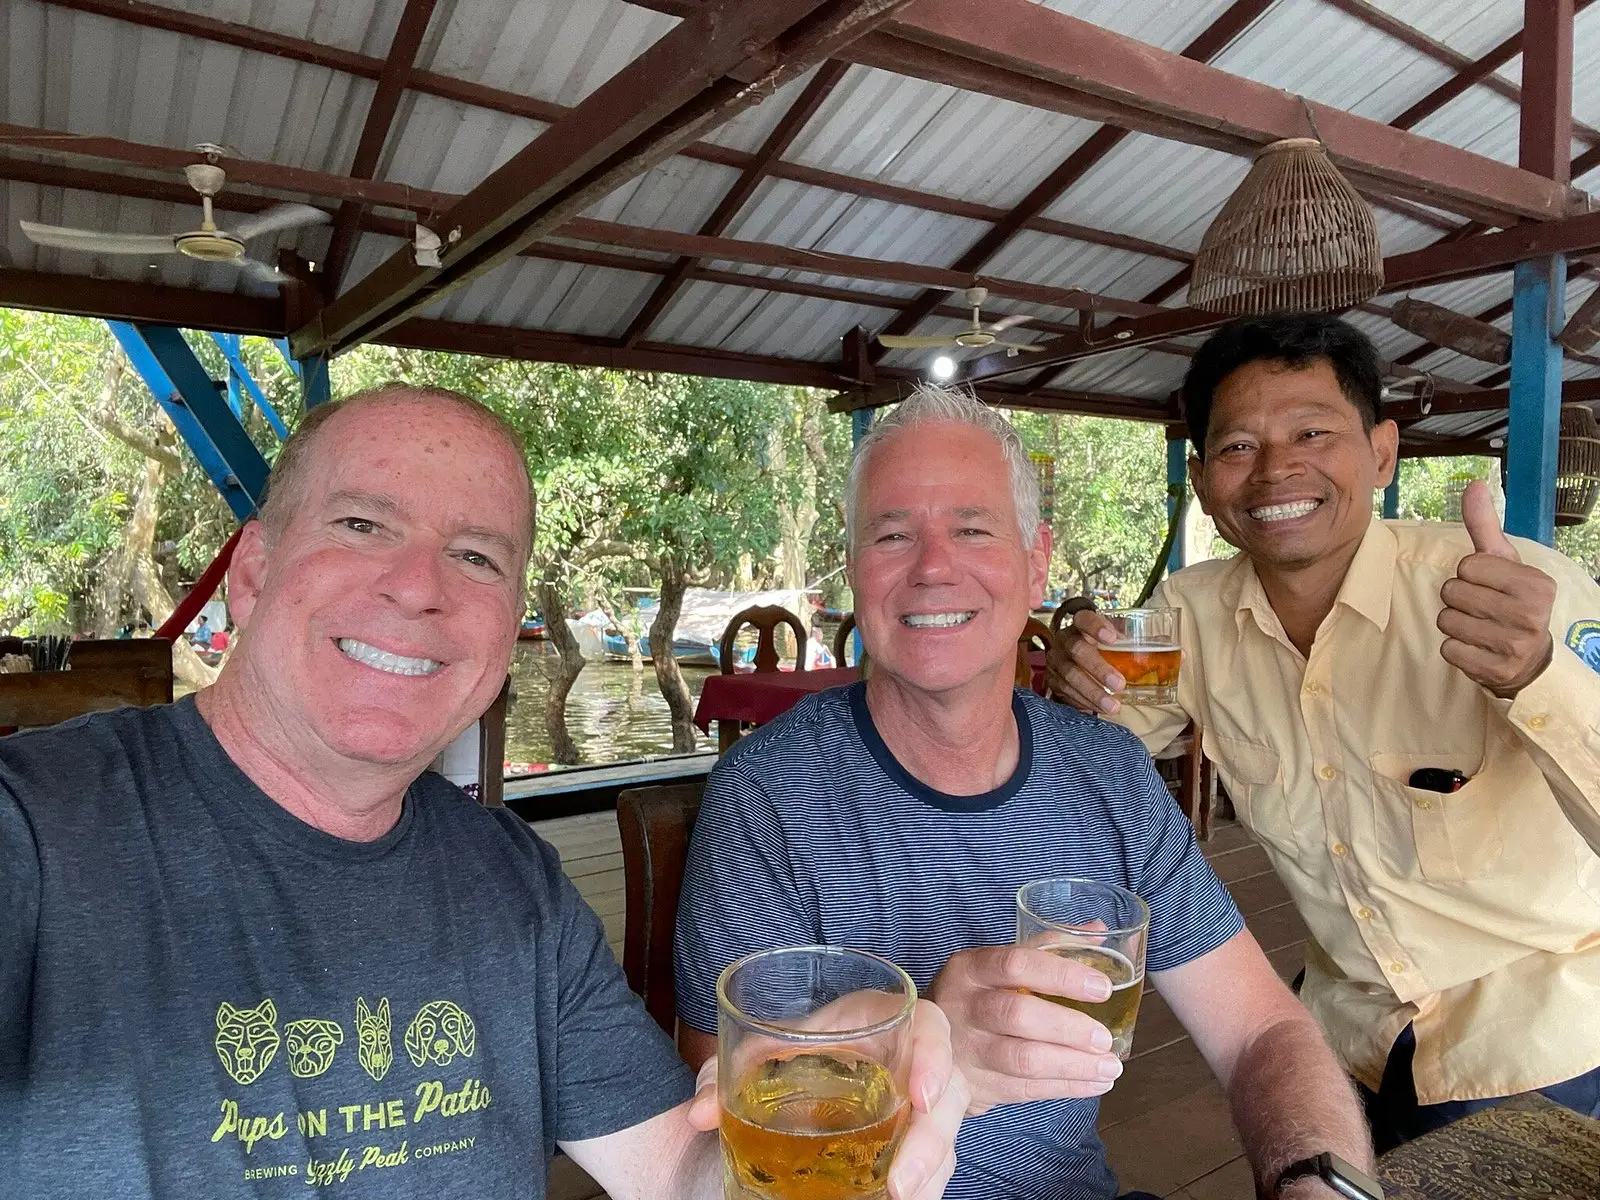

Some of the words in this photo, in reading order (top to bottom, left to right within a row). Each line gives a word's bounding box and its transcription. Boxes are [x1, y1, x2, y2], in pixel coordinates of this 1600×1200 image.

[211, 1098, 288, 1153] Pups
[339, 1099, 406, 1133] THE
[413, 1078, 492, 1123] Patio
[244, 1165, 298, 1180] BREWING
[358, 1140, 408, 1170] Peak
[415, 1137, 476, 1159] COMPANY
